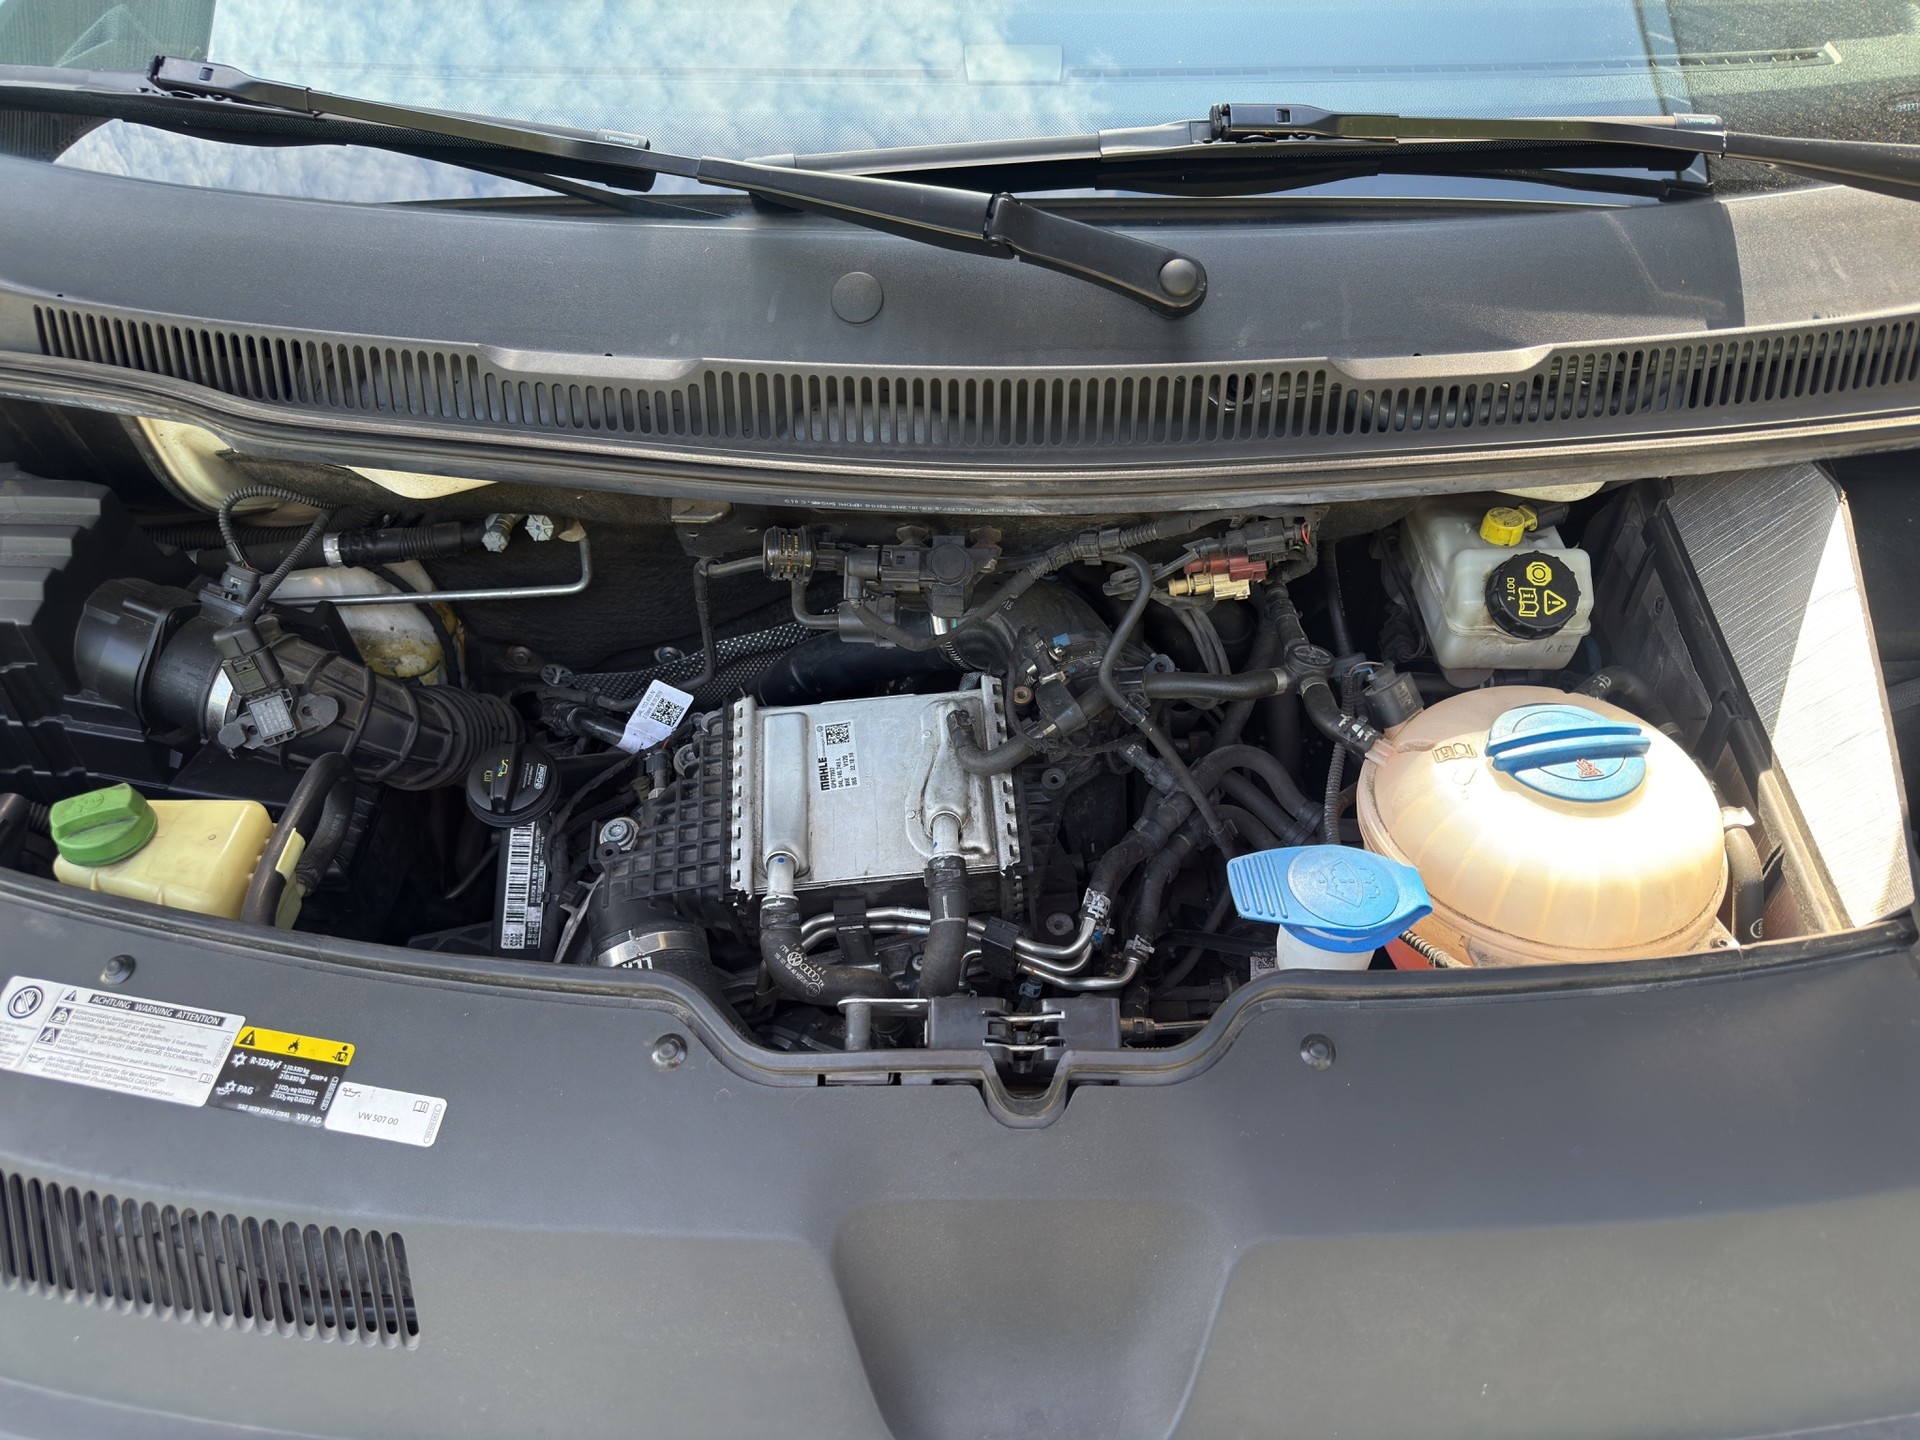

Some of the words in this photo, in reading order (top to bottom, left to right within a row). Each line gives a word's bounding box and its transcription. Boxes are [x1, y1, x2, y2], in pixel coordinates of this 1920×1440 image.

[608, 135, 638, 145] Continental
[1506, 577, 1515, 594] DOT
[818, 756, 830, 790] MAHLE
[91, 996, 133, 1009] ACHTUNG
[133, 1003, 174, 1016] WARNING
[176, 1011, 221, 1025] ATTENTION
[248, 1056, 282, 1071] R-1234yf
[235, 1085, 254, 1095] PAG
[295, 1113, 309, 1121] VW
[308, 1115, 322, 1124] AG
[357, 1111, 372, 1120] VW
[372, 1114, 386, 1123] 507
[387, 1116, 399, 1125] 00
